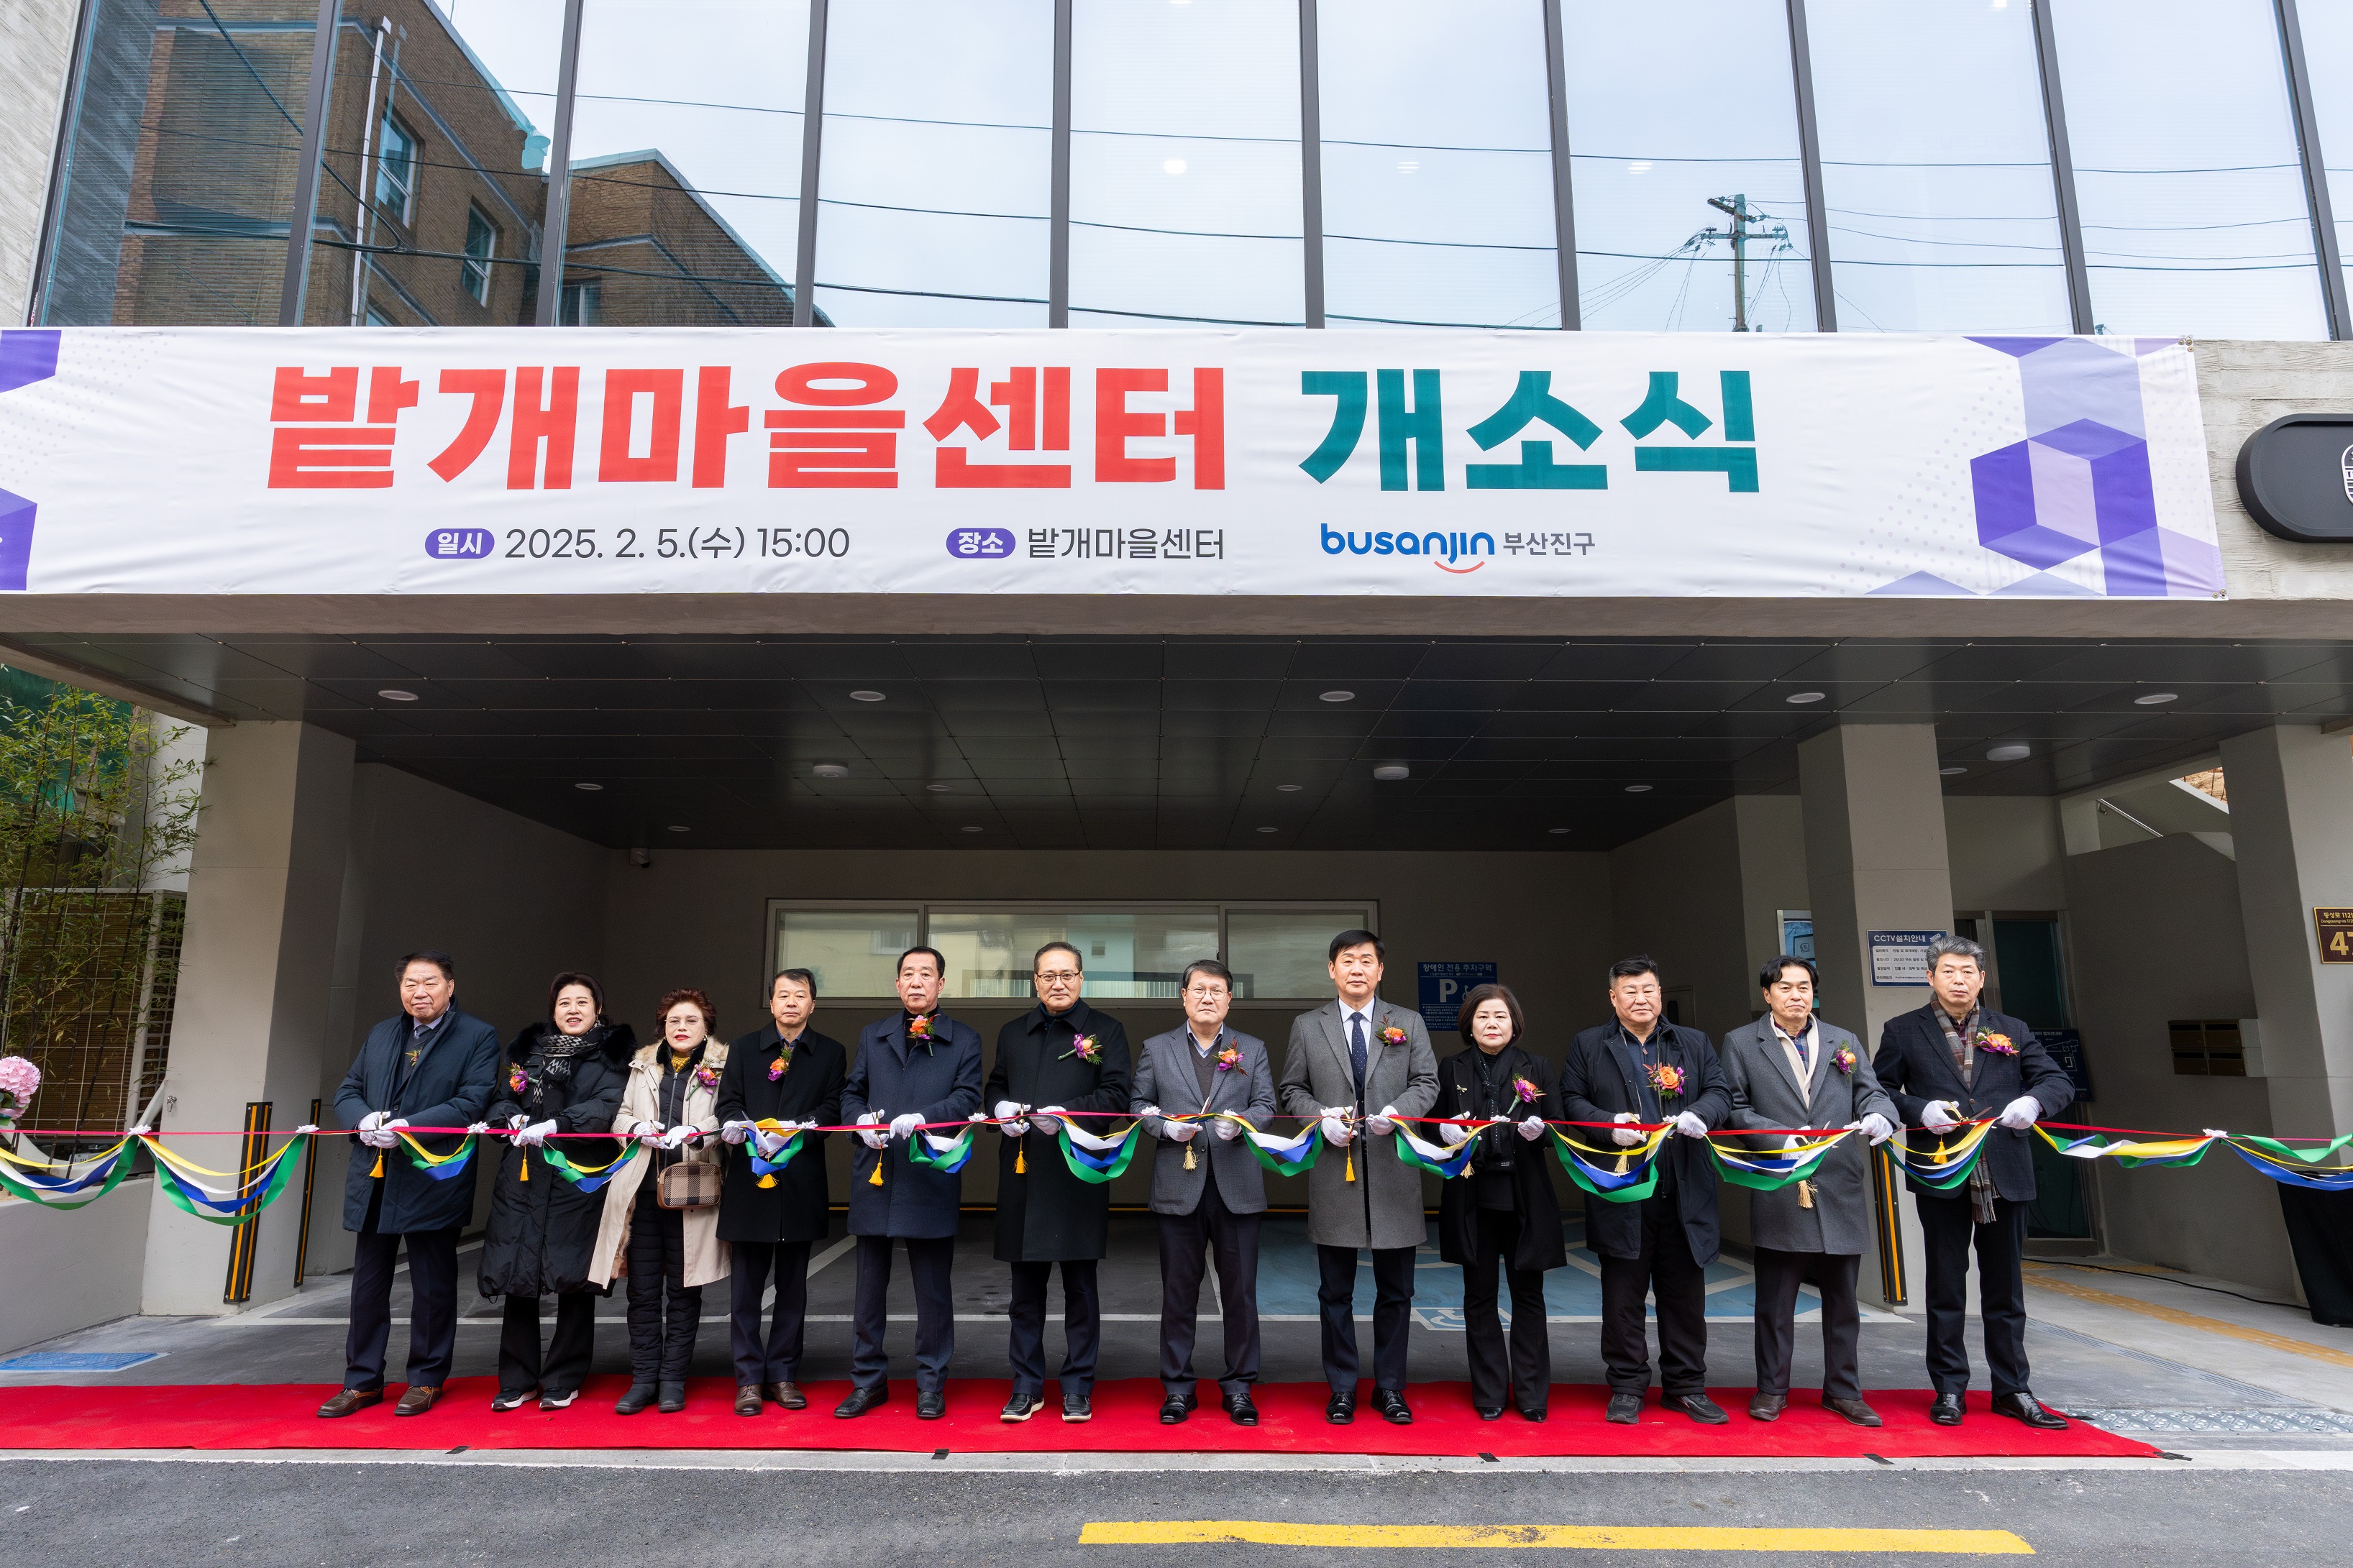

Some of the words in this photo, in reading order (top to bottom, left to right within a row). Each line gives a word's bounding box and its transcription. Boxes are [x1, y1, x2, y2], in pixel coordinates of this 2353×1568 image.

[268, 362, 1225, 490] 밭개마을센터
[1298, 368, 1760, 492] 개소식
[437, 532, 483, 554] 일시
[505, 528, 603, 559] 2025.
[615, 528, 644, 559] 2.
[657, 526, 745, 559] 5.(수)
[757, 528, 850, 558] 15:00
[958, 532, 1004, 554] 장소
[1028, 528, 1223, 559] 밭개마을센터
[1320, 523, 1495, 564] busanjin
[1503, 532, 1596, 556] 부산진구
[1422, 963, 1445, 972] 장애인
[1446, 963, 1461, 972] 전용
[1463, 963, 1492, 972] 주차구역
[1439, 978, 1458, 1003] P
